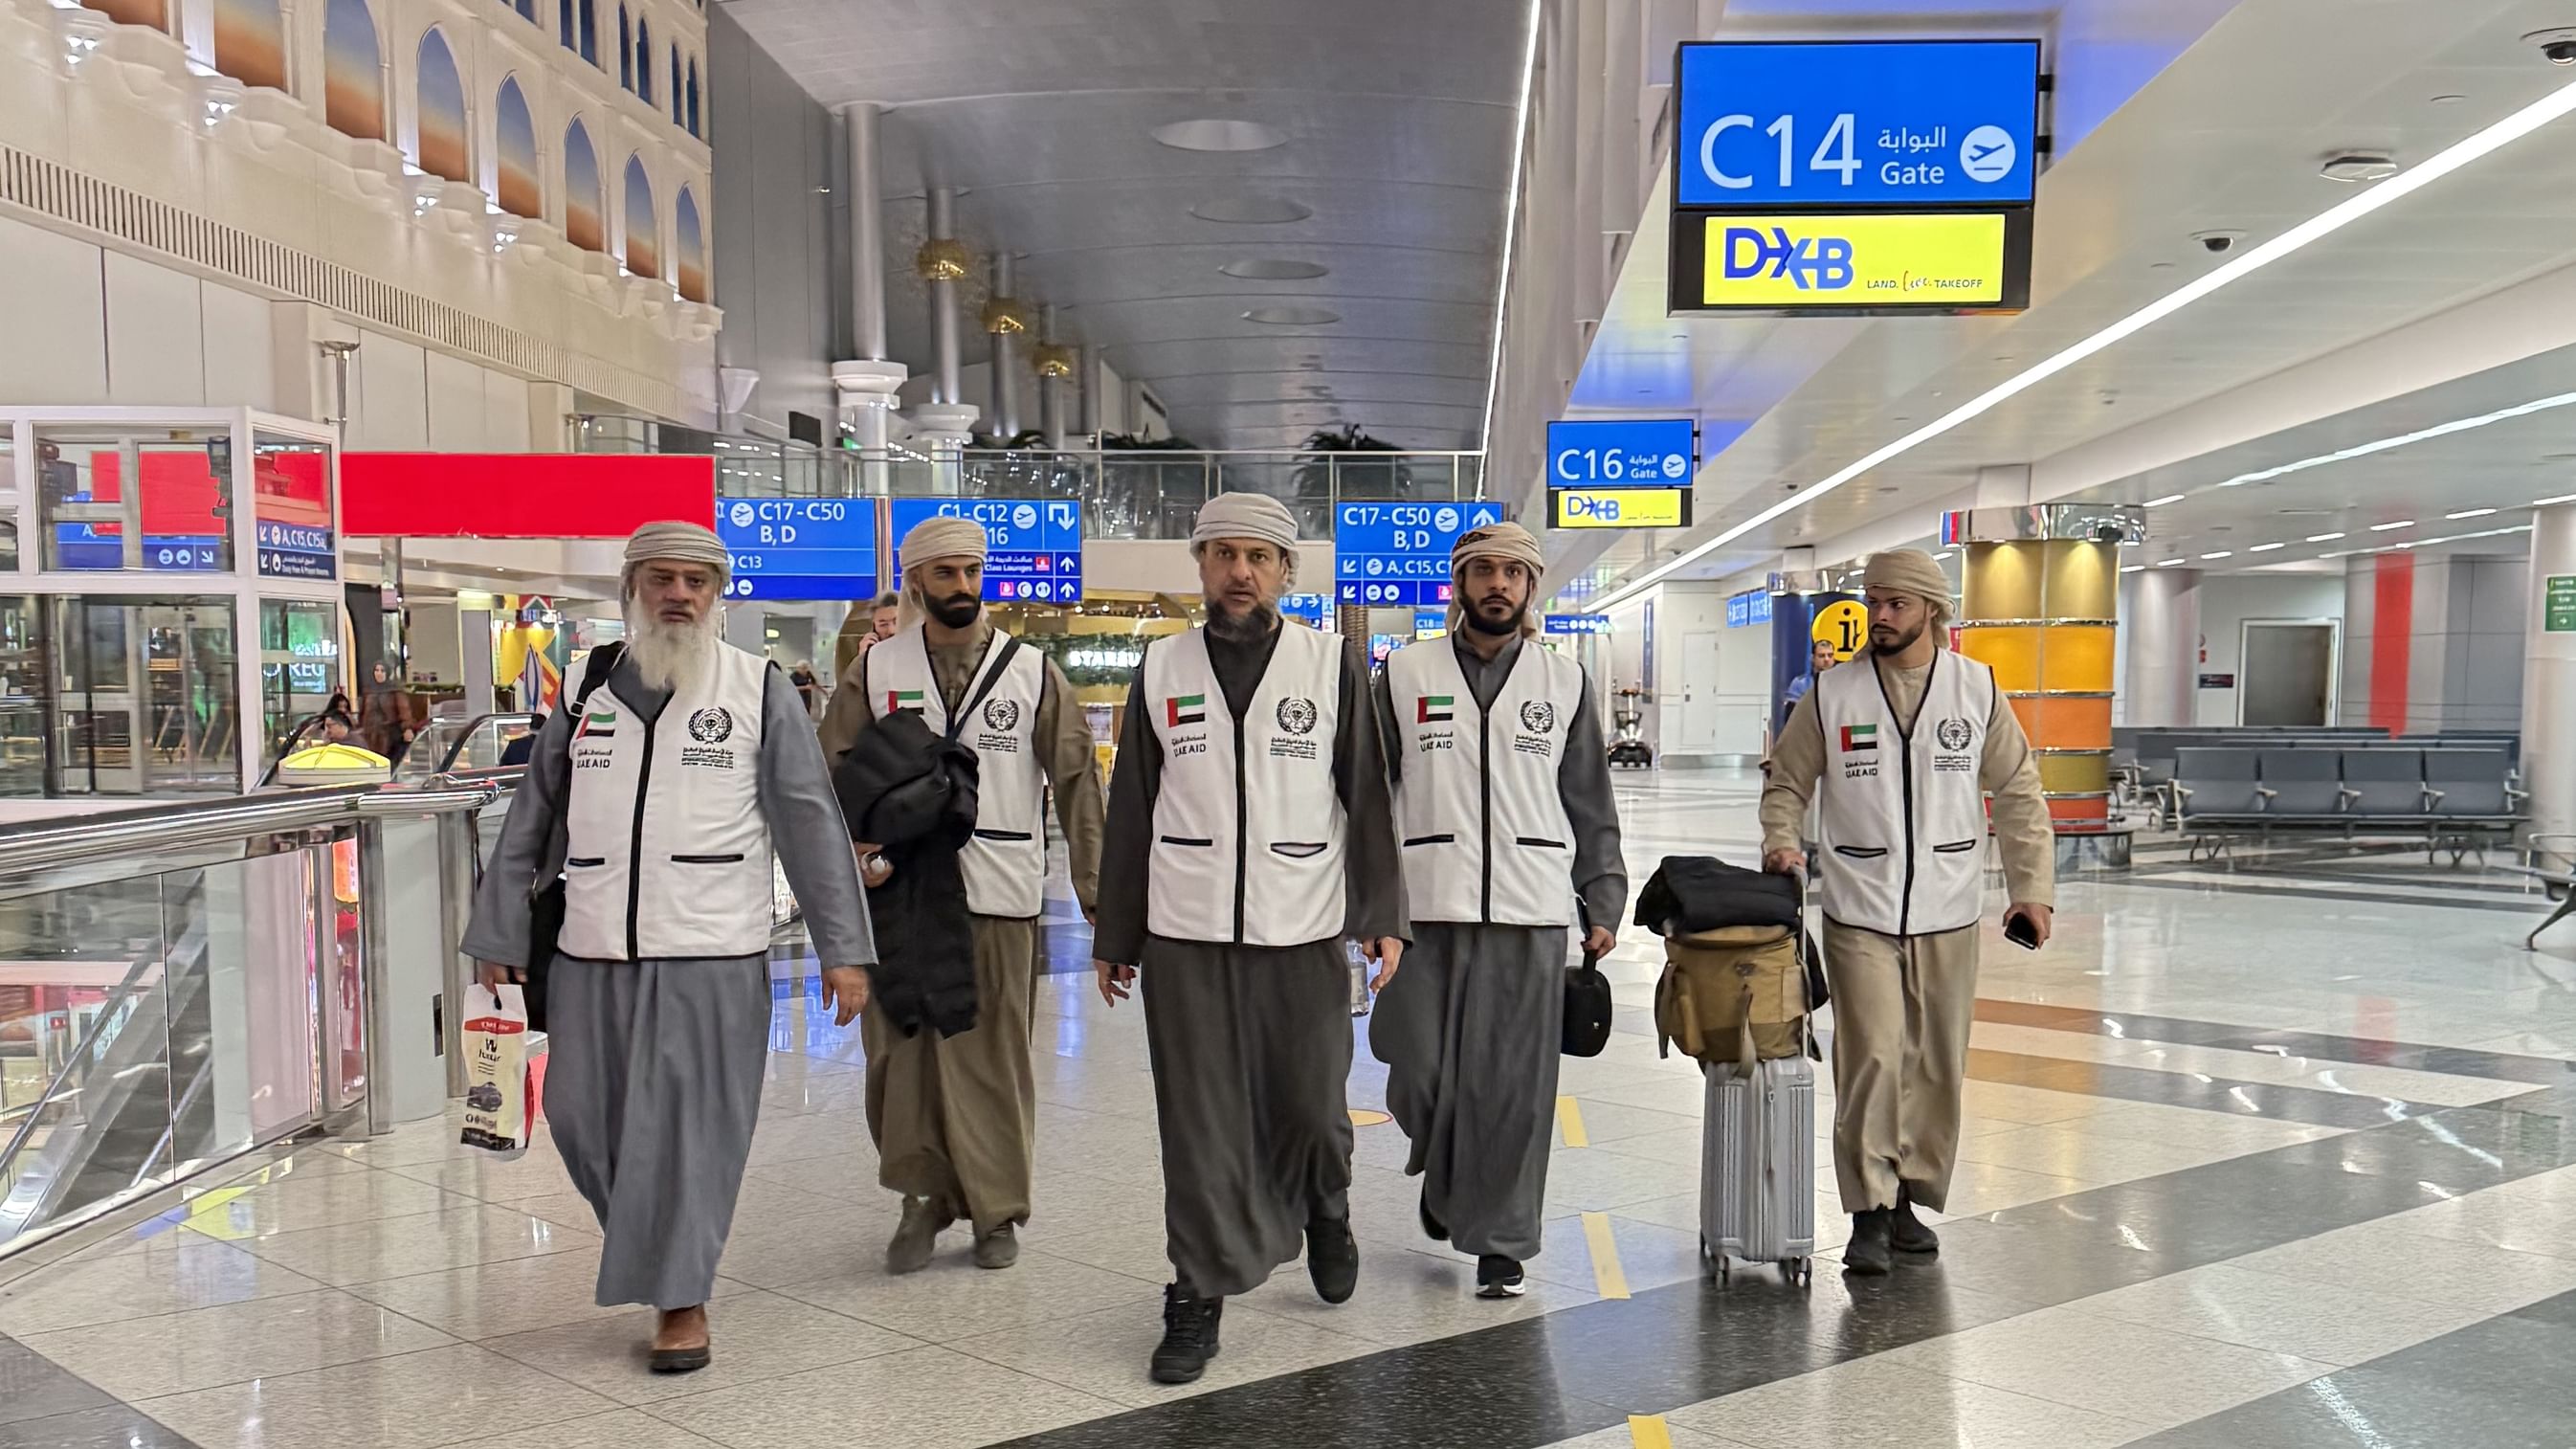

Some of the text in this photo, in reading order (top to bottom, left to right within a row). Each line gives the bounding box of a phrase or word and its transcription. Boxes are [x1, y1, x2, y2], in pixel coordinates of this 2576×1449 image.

[1877, 126, 1947, 154] البوابة
[1699, 112, 1862, 189] C14
[1880, 162, 1945, 185] Gate
[1867, 279, 1899, 289] LAND.
[1934, 279, 1983, 288] TAKEOFF
[1557, 448, 1624, 480] C16
[1631, 467, 1657, 479] Gate
[760, 524, 796, 546] B, D
[983, 527, 1009, 545] 16
[1393, 530, 1431, 551] B, D
[738, 555, 763, 568] C13
[1387, 559, 1402, 575] A,
[1405, 560, 1433, 575] C15,
[1069, 650, 1144, 667] STARBU
[1188, 744, 1206, 753] AID
[1435, 741, 1453, 749] AID
[592, 759, 611, 768] AID
[1862, 768, 1877, 776] AID
